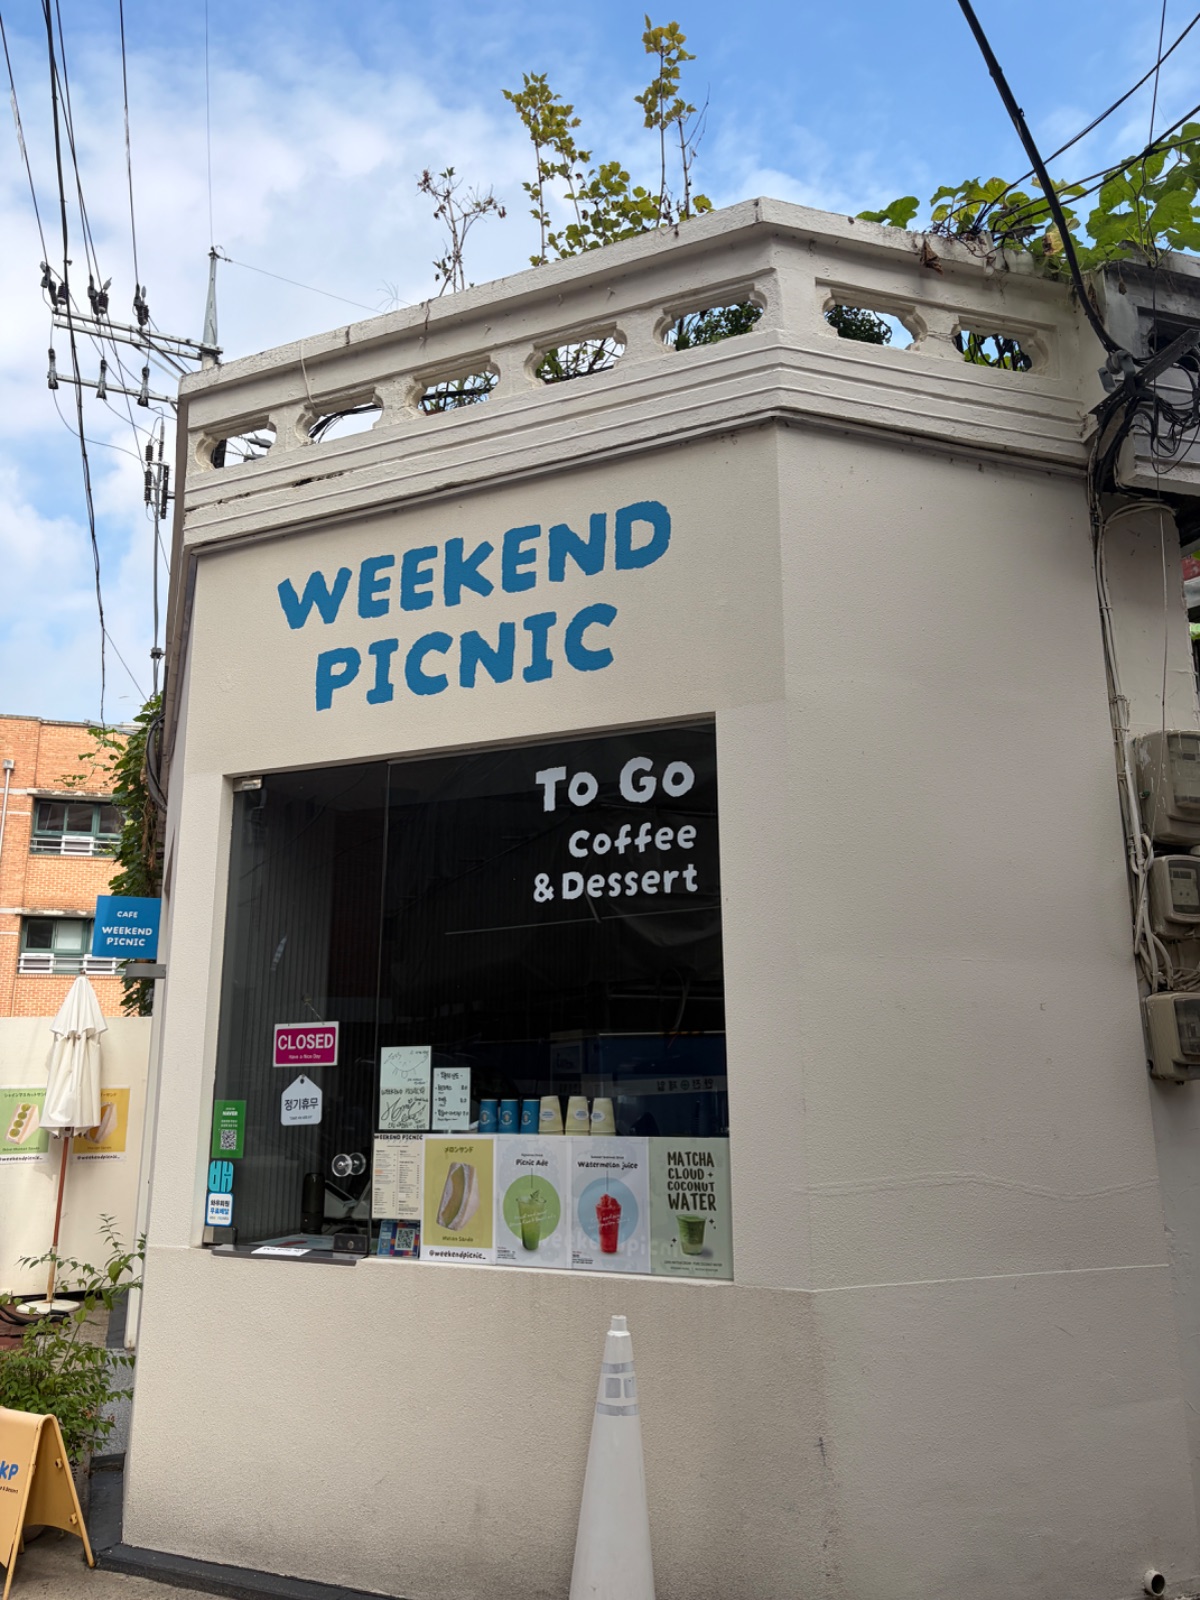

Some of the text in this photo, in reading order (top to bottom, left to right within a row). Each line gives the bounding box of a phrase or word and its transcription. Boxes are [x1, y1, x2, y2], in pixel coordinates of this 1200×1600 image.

[276, 500, 672, 629] WEEKEND
[315, 603, 618, 711] PICNIC
[535, 756, 695, 812] To Go
[568, 822, 697, 858] Coffee
[533, 863, 699, 903] & Dessert
[116, 910, 138, 918] CAFE
[102, 926, 152, 936] WEEKEND
[106, 937, 146, 946] PICNIC
[278, 1033, 334, 1050] CLOSED
[284, 1097, 319, 1111] 정기휴무
[516, 1158, 534, 1166] Picnic
[622, 1161, 638, 1170] juice
[667, 1152, 714, 1167] MATCHA
[668, 1168, 704, 1180] CLOUD
[667, 1181, 715, 1192] COCONUT
[668, 1192, 716, 1211] WATER
[429, 1250, 486, 1260] @weekendpicnic_
